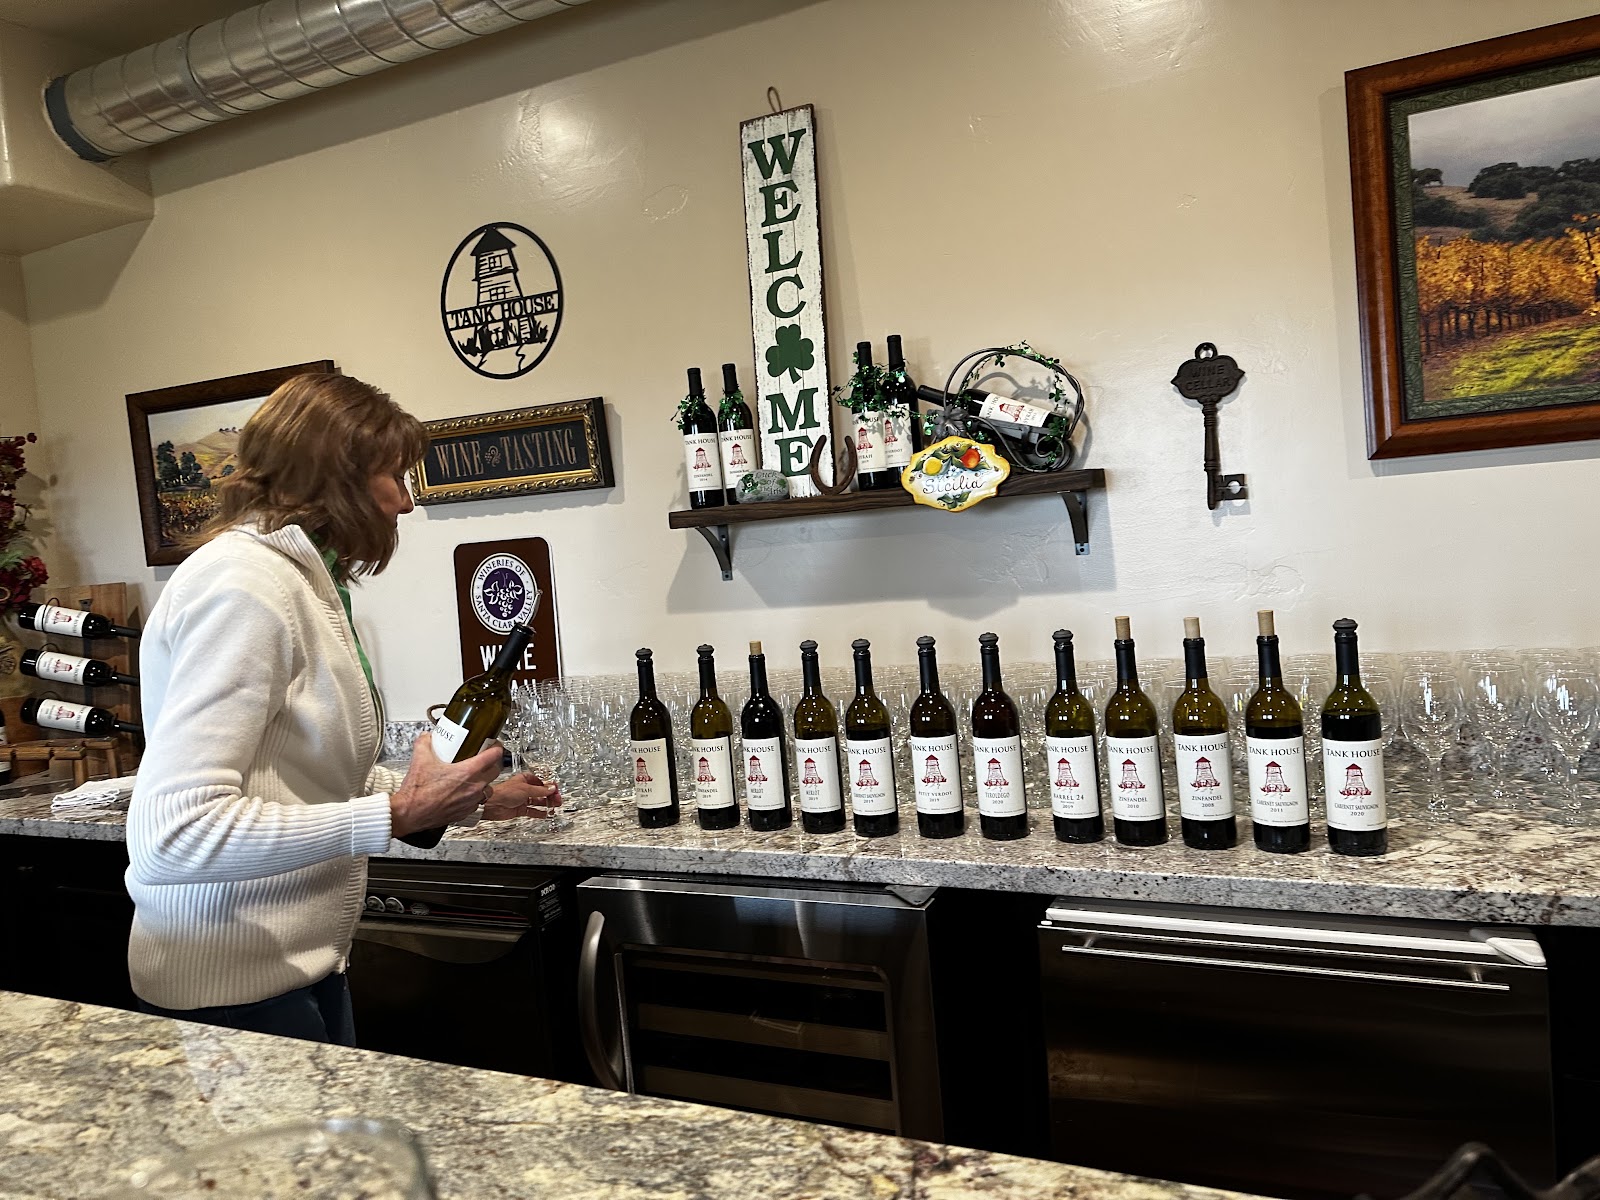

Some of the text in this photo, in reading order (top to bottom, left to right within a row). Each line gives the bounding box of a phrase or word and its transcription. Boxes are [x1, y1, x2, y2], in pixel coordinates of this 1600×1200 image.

[452, 295, 555, 328] TANK HOUSE
[1191, 364, 1226, 378] WINE
[1185, 377, 1232, 392] CELLAR
[434, 428, 577, 479] WINE TASTING
[922, 475, 985, 495] Sicilia
[477, 558, 526, 581] WINERIES OF
[475, 595, 491, 623] SANTA
[518, 589, 533, 622] VALLEY
[480, 643, 537, 672] WE
[638, 745, 662, 754] HOUSE
[701, 745, 724, 753] HOUSE
[751, 745, 775, 753] HOUSE
[807, 745, 832, 754] HOUSE
[862, 746, 886, 755] HOUSE
[928, 743, 953, 752] HOUSE
[991, 744, 1017, 754] HOUSE
[1060, 745, 1089, 753] HOUSE
[1126, 745, 1154, 754] HOUSE
[1177, 742, 1228, 752] TANK HOUSE
[1249, 746, 1300, 756] TANK HOUSE
[1326, 748, 1381, 758] TANK HOUSE
[1053, 793, 1074, 801] BARREL
[1256, 799, 1275, 807] CABERNET
[1334, 802, 1379, 811] CABERNET SAUVIGNON
